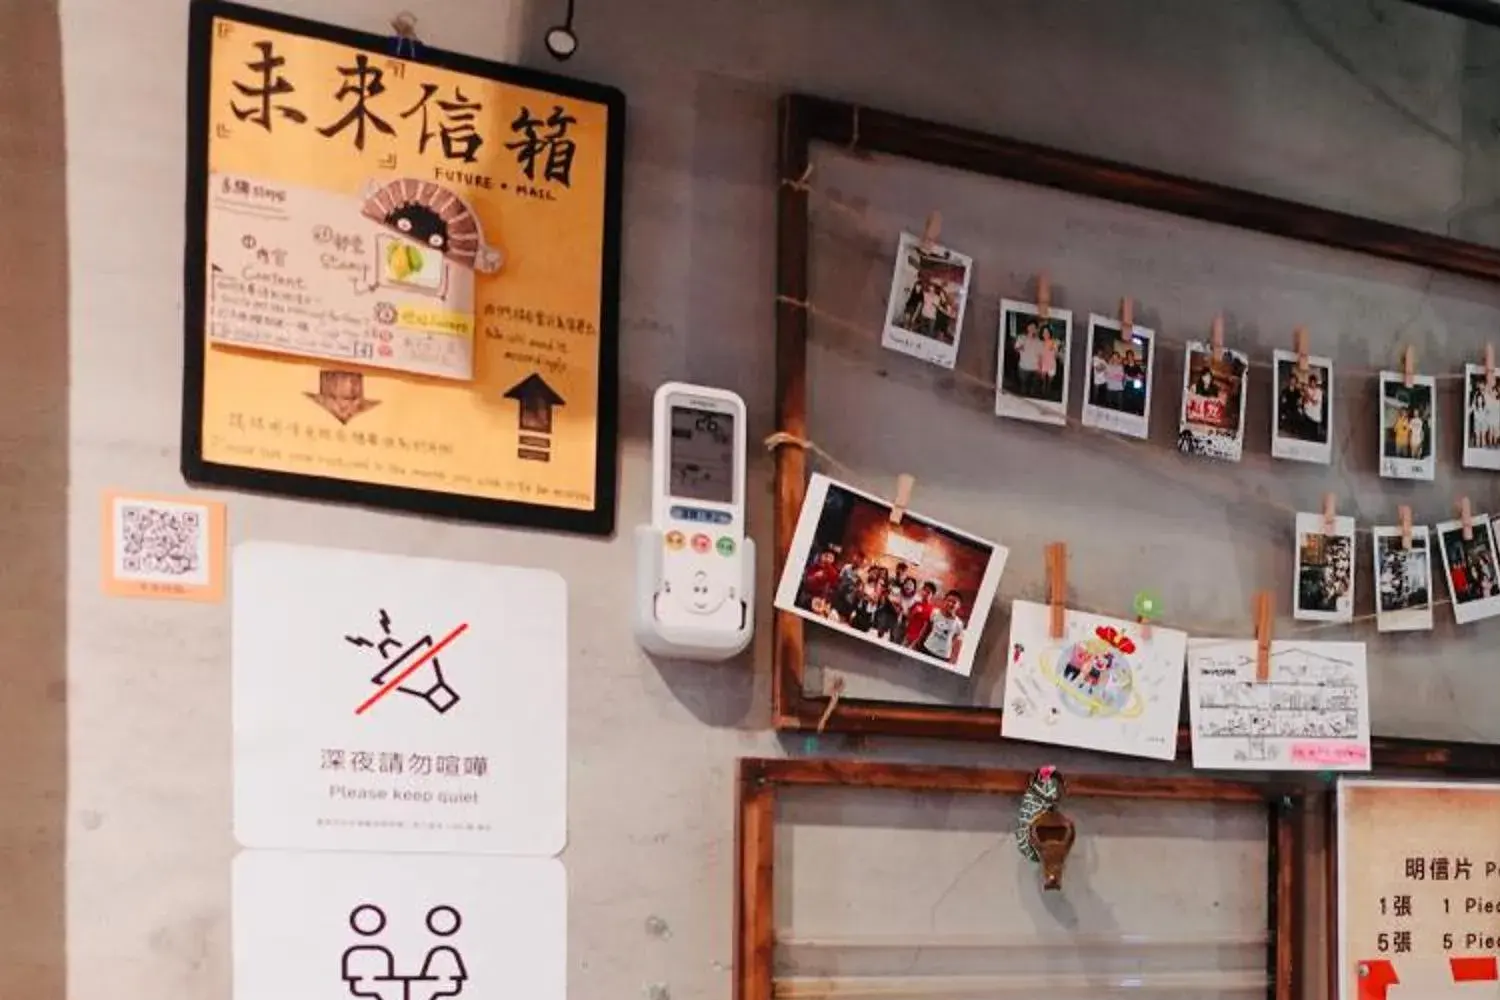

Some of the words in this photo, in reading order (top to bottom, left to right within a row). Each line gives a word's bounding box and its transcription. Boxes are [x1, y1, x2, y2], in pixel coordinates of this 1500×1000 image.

[229, 41, 578, 189] 未來信箱
[435, 167, 493, 190] FUTURE
[517, 185, 556, 201] MAIL
[320, 749, 489, 777] 深夜請勿喧嘩
[329, 785, 388, 801] Please
[393, 785, 434, 804] keep
[438, 787, 479, 805] quiet
[1405, 858, 1472, 881] 明信片
[1379, 896, 1413, 917] 1張
[1443, 899, 1450, 913] 1
[1378, 931, 1412, 953] 5張
[1443, 934, 1453, 949] 5
